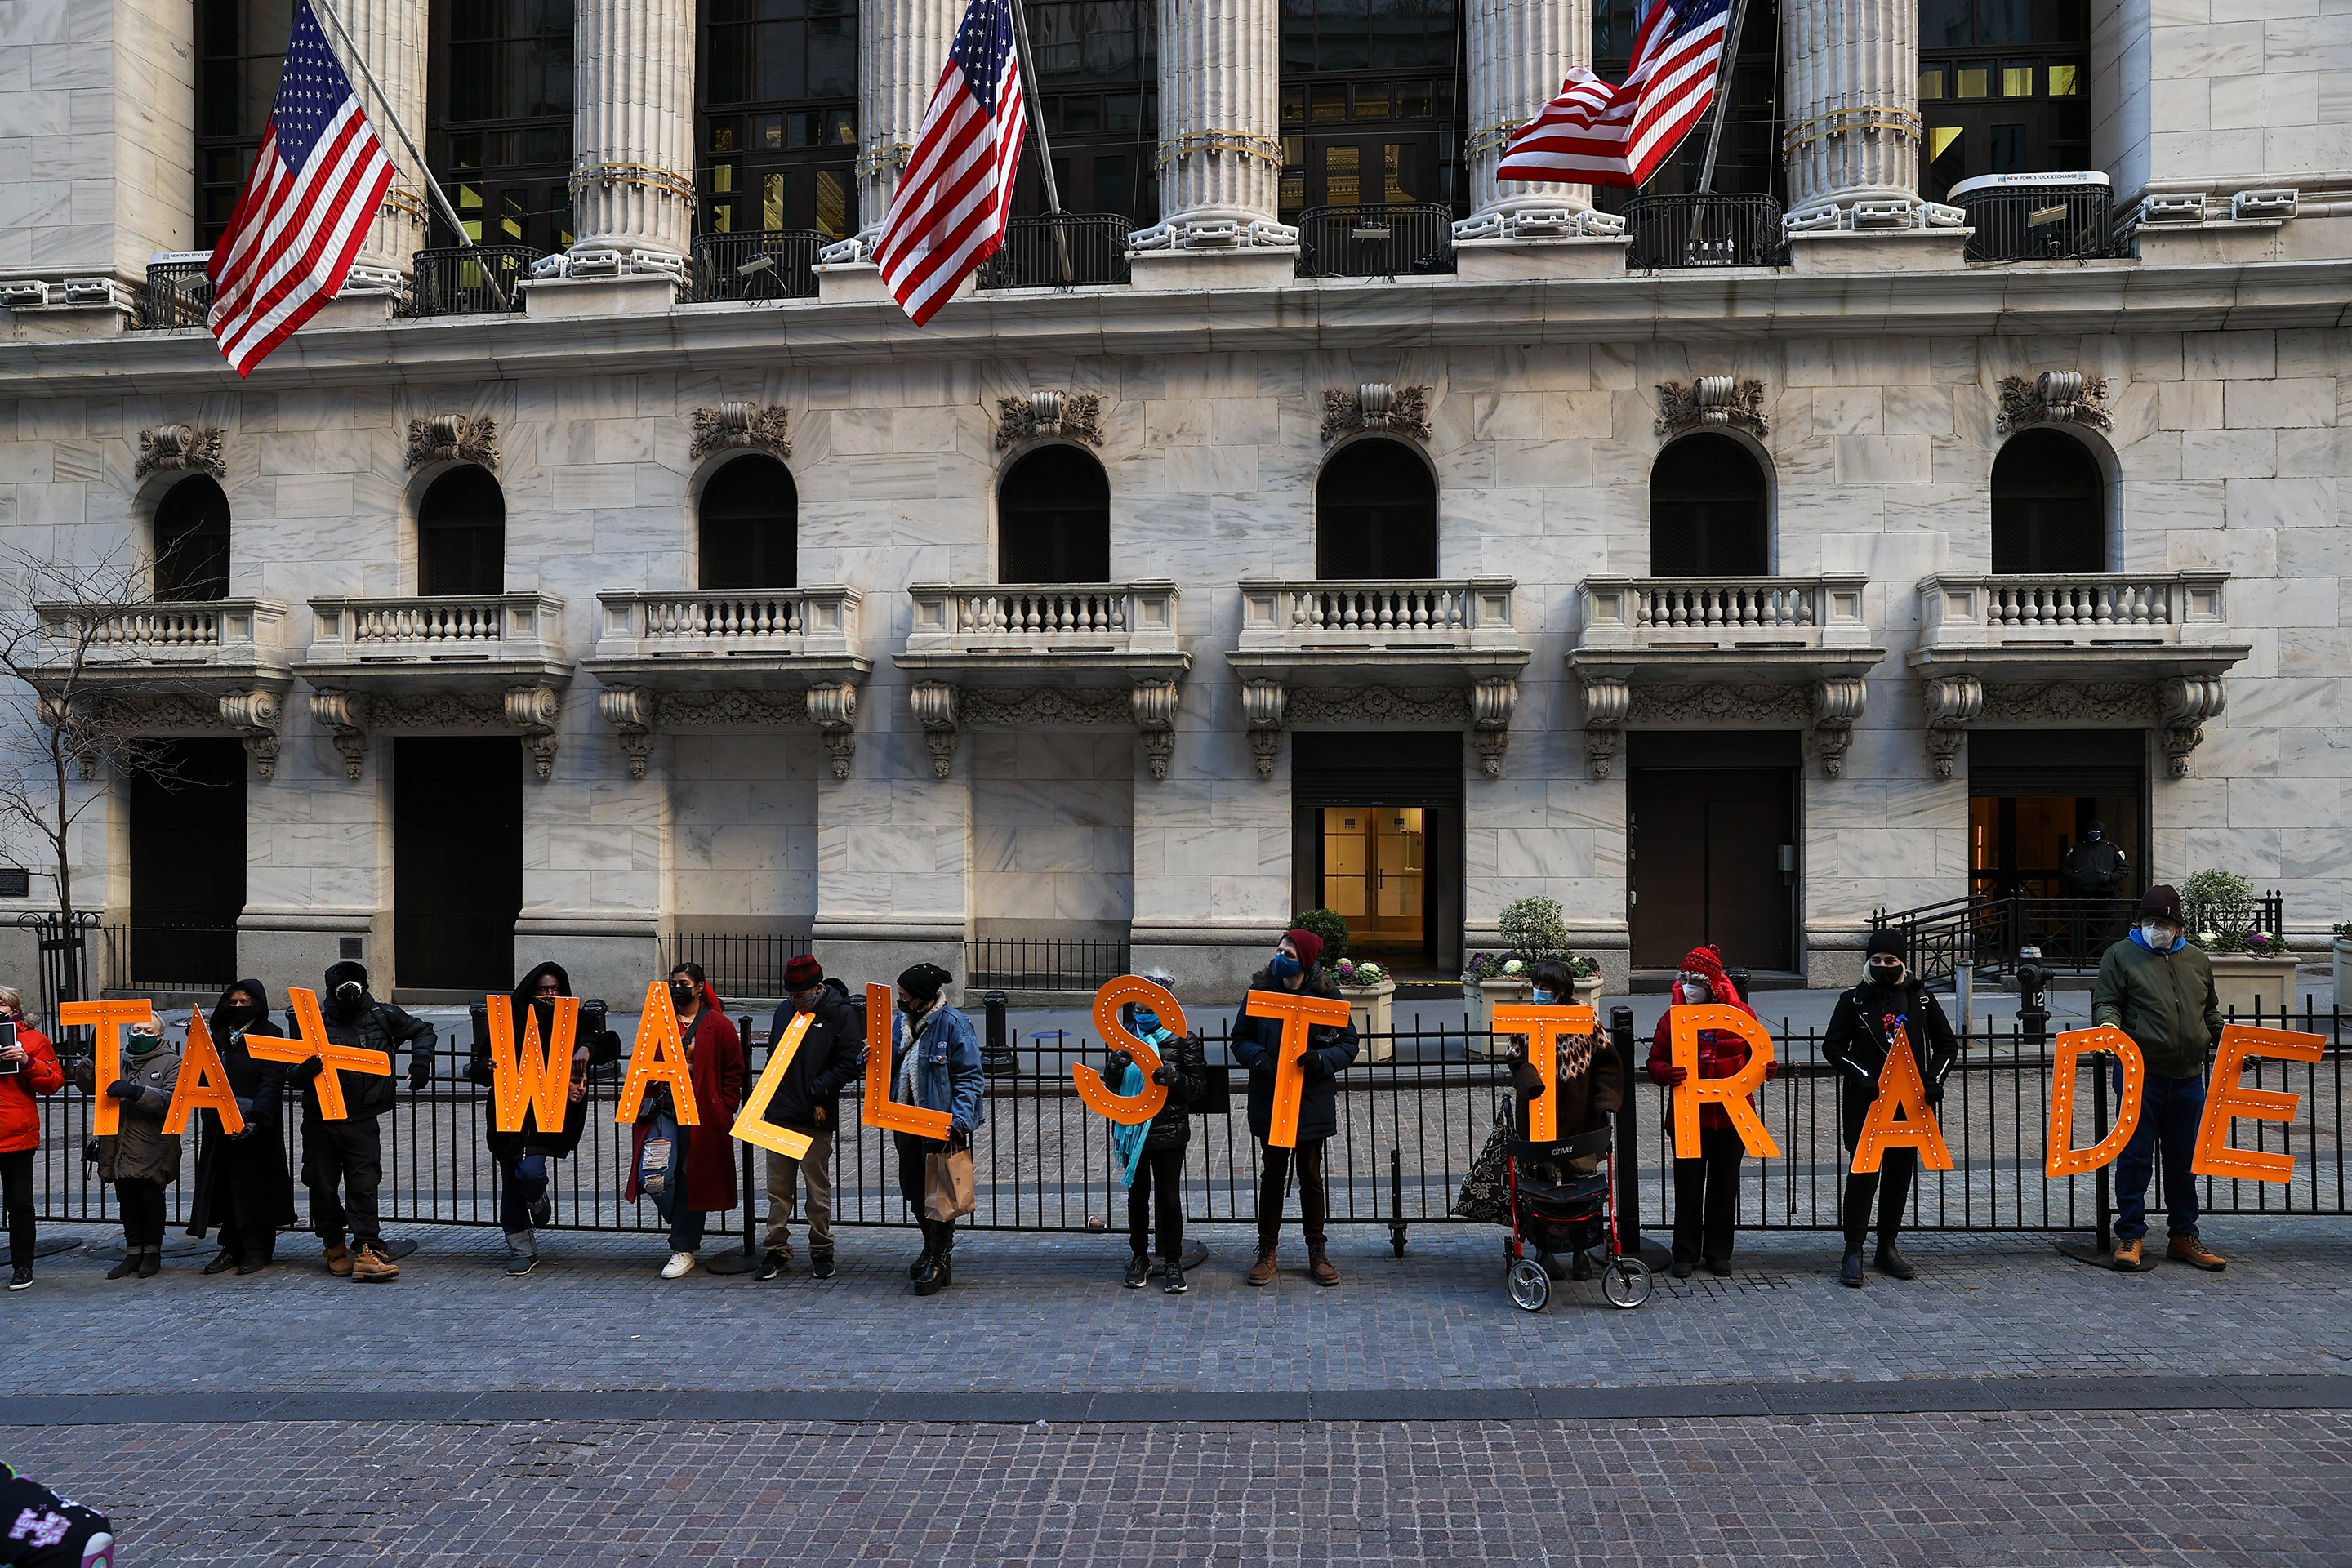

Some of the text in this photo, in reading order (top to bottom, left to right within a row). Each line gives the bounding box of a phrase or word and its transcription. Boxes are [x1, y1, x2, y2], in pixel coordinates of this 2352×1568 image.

[2032, 991, 2045, 1007] 12
[60, 975, 2328, 1183] TAX WALL ST TRADE
[1552, 1145, 1573, 1156] drive
[12, 1510, 37, 1535] HEY
[33, 1513, 60, 1544] LOVE
